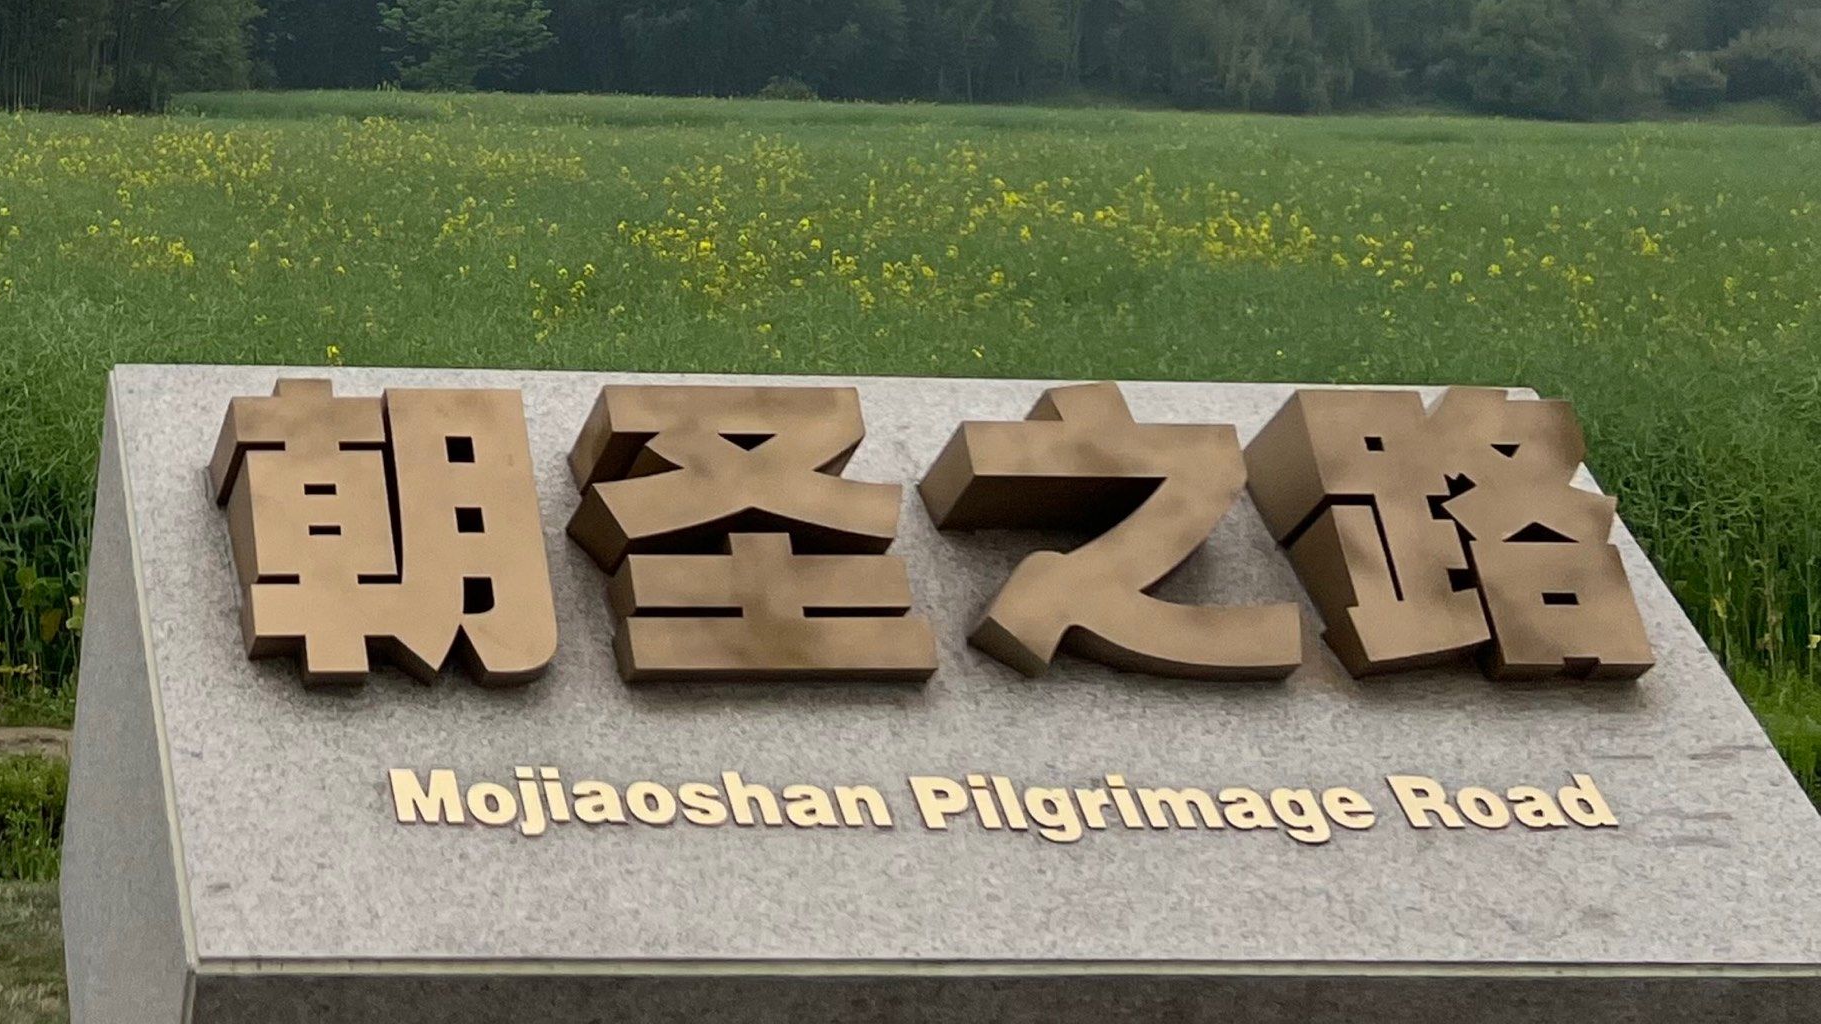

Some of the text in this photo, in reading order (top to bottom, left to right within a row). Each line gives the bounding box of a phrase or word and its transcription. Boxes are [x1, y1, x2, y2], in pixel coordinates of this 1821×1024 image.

[216, 378, 1656, 682] 朝圣之路
[387, 765, 1621, 844] Mojiaoshan Pilgrimage Road
